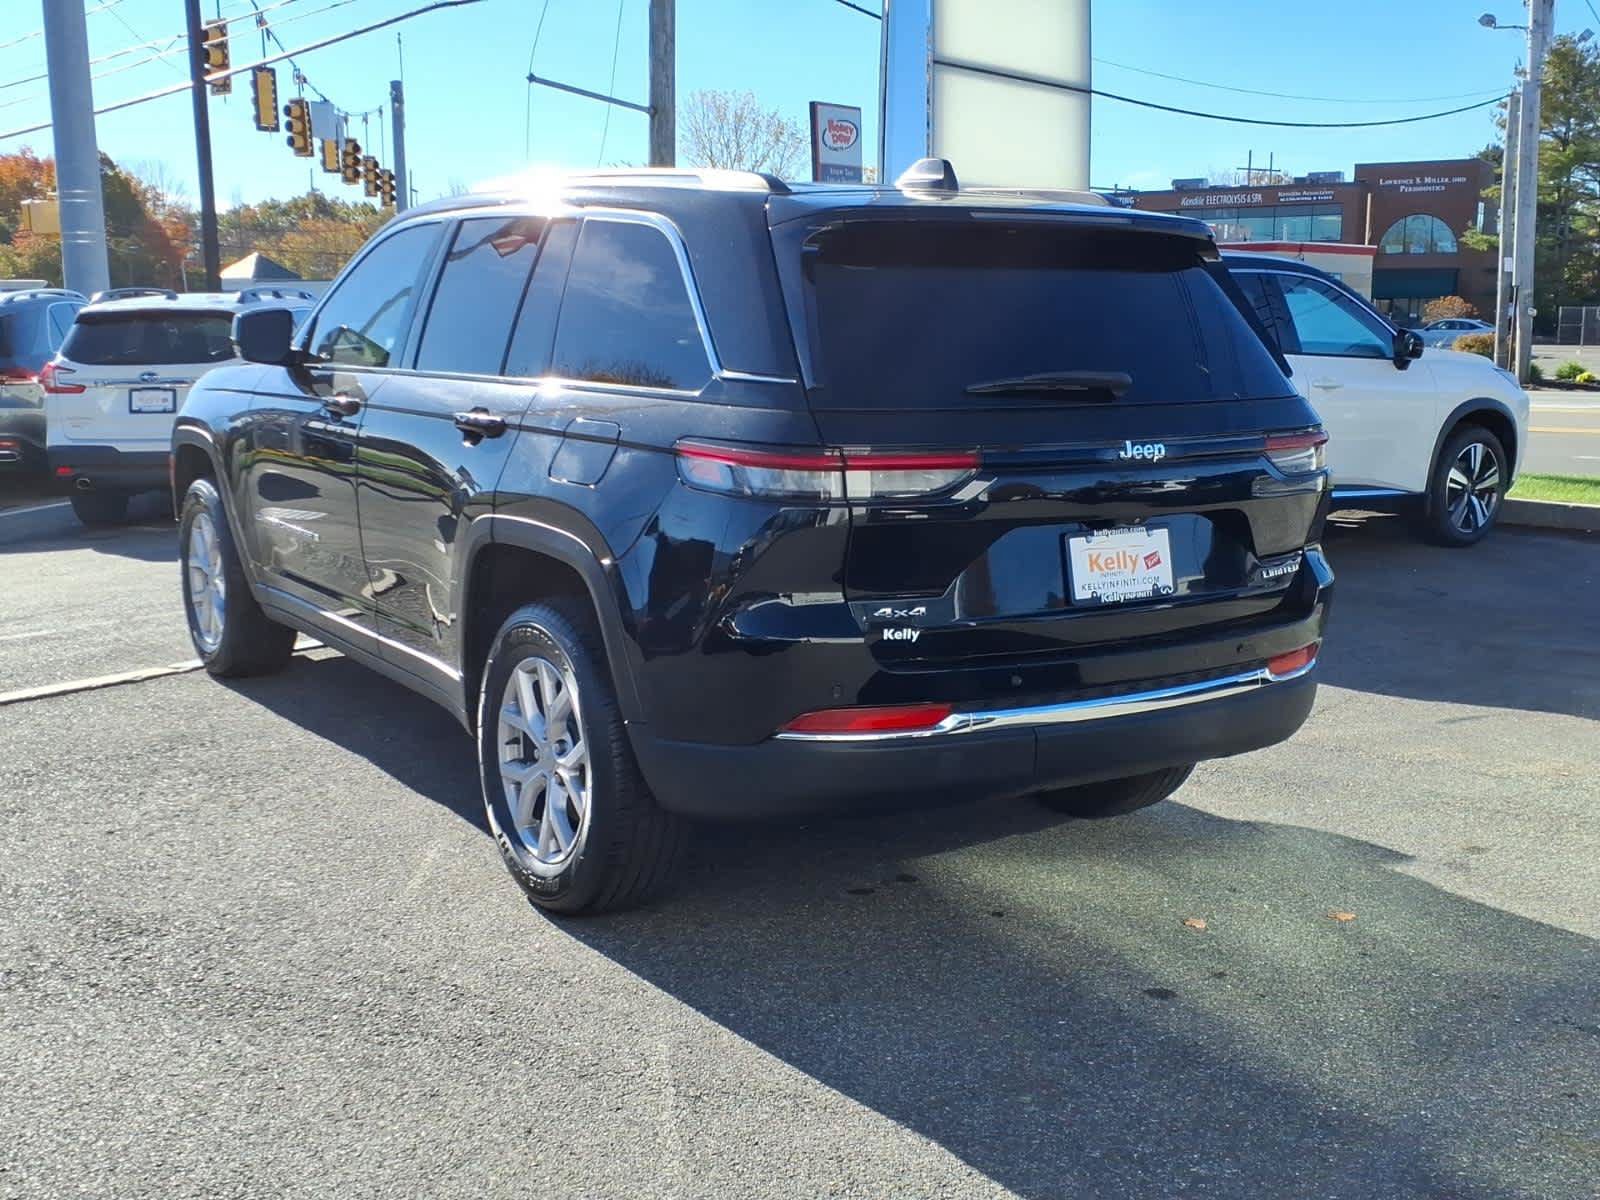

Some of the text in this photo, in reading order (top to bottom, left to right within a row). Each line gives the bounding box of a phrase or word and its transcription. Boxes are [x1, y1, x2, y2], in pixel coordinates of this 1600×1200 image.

[1206, 193, 1246, 205] ELECTROLYSIS
[1119, 439, 1166, 463] Jeep
[1087, 549, 1139, 575] Kelly
[1081, 575, 1160, 591] KELLYINFINITI.COM
[873, 606, 927, 618] 4x4
[883, 628, 920, 643] Kelly
